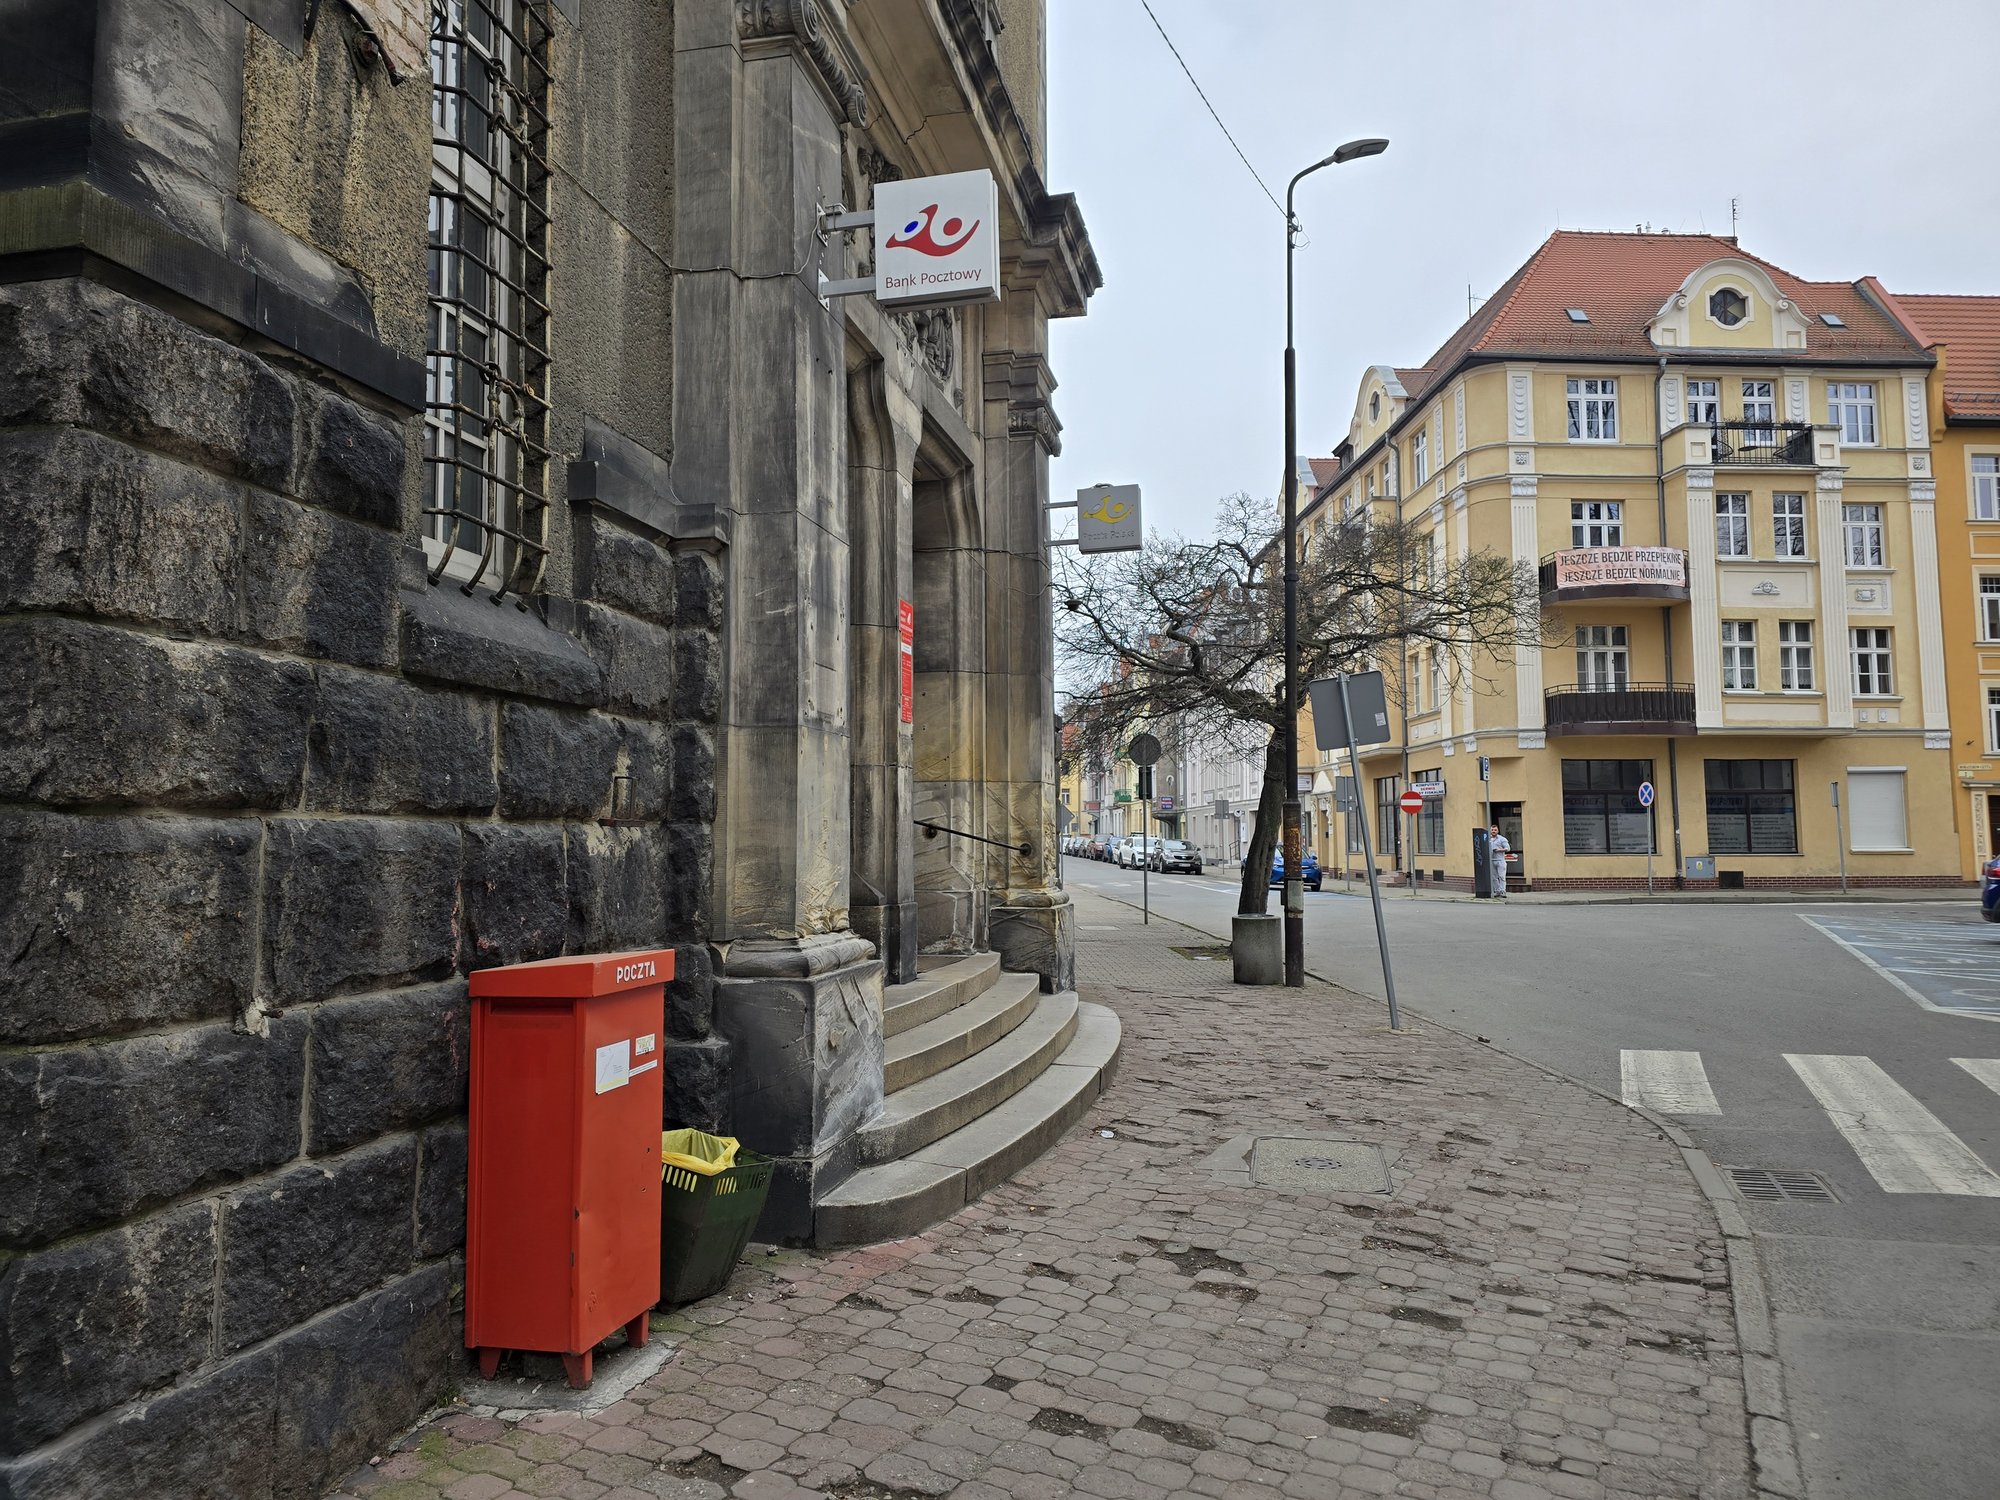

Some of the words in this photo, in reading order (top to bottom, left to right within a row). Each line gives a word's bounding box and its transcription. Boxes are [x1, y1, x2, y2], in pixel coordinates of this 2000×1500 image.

[885, 273, 917, 289] Bank
[921, 268, 982, 285] Pocztowy
[1560, 552, 1599, 566] JESZCZE
[1601, 551, 1634, 565] BĘDZIE
[1563, 569, 1603, 583] JESZCZE
[1605, 568, 1637, 581] BĘDZIE
[1639, 567, 1681, 581] NORMALNIE
[616, 961, 656, 984] POCZTA
